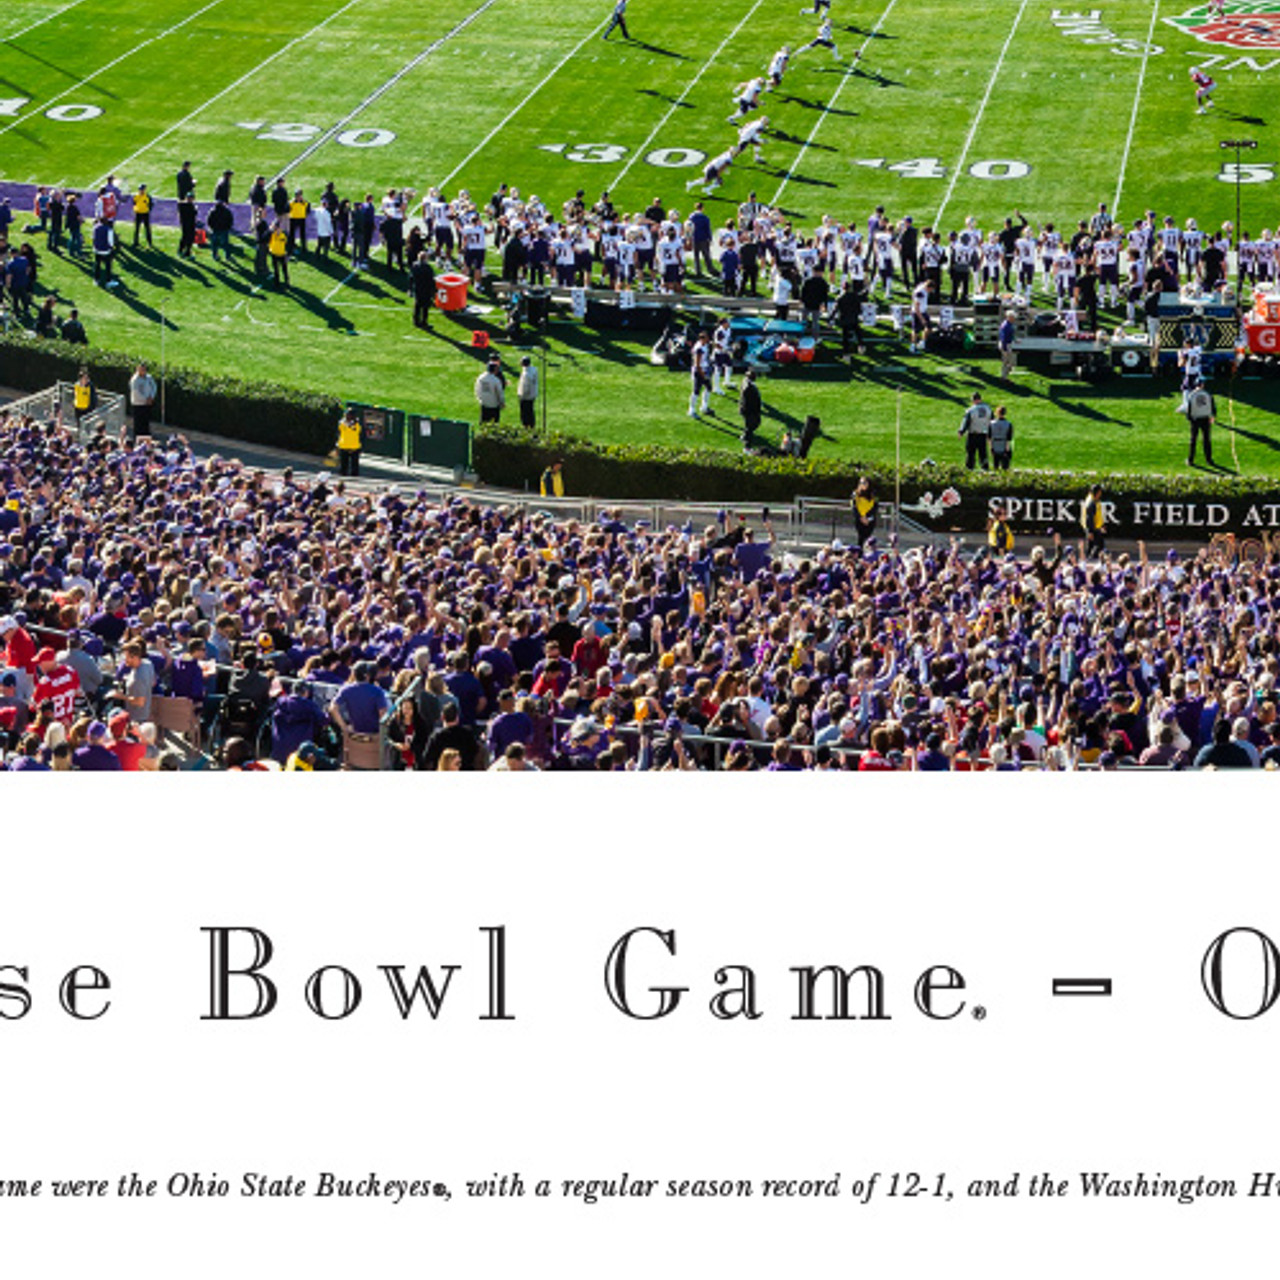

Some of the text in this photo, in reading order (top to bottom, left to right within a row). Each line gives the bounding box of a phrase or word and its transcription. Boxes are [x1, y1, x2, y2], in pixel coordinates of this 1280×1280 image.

[256, 122, 397, 149] 20
[564, 142, 708, 169] 30
[887, 157, 1032, 180] 40
[1258, 328, 1277, 348] G
[988, 496, 1121, 524] SPIEKR
[1133, 502, 1231, 526] FIELD
